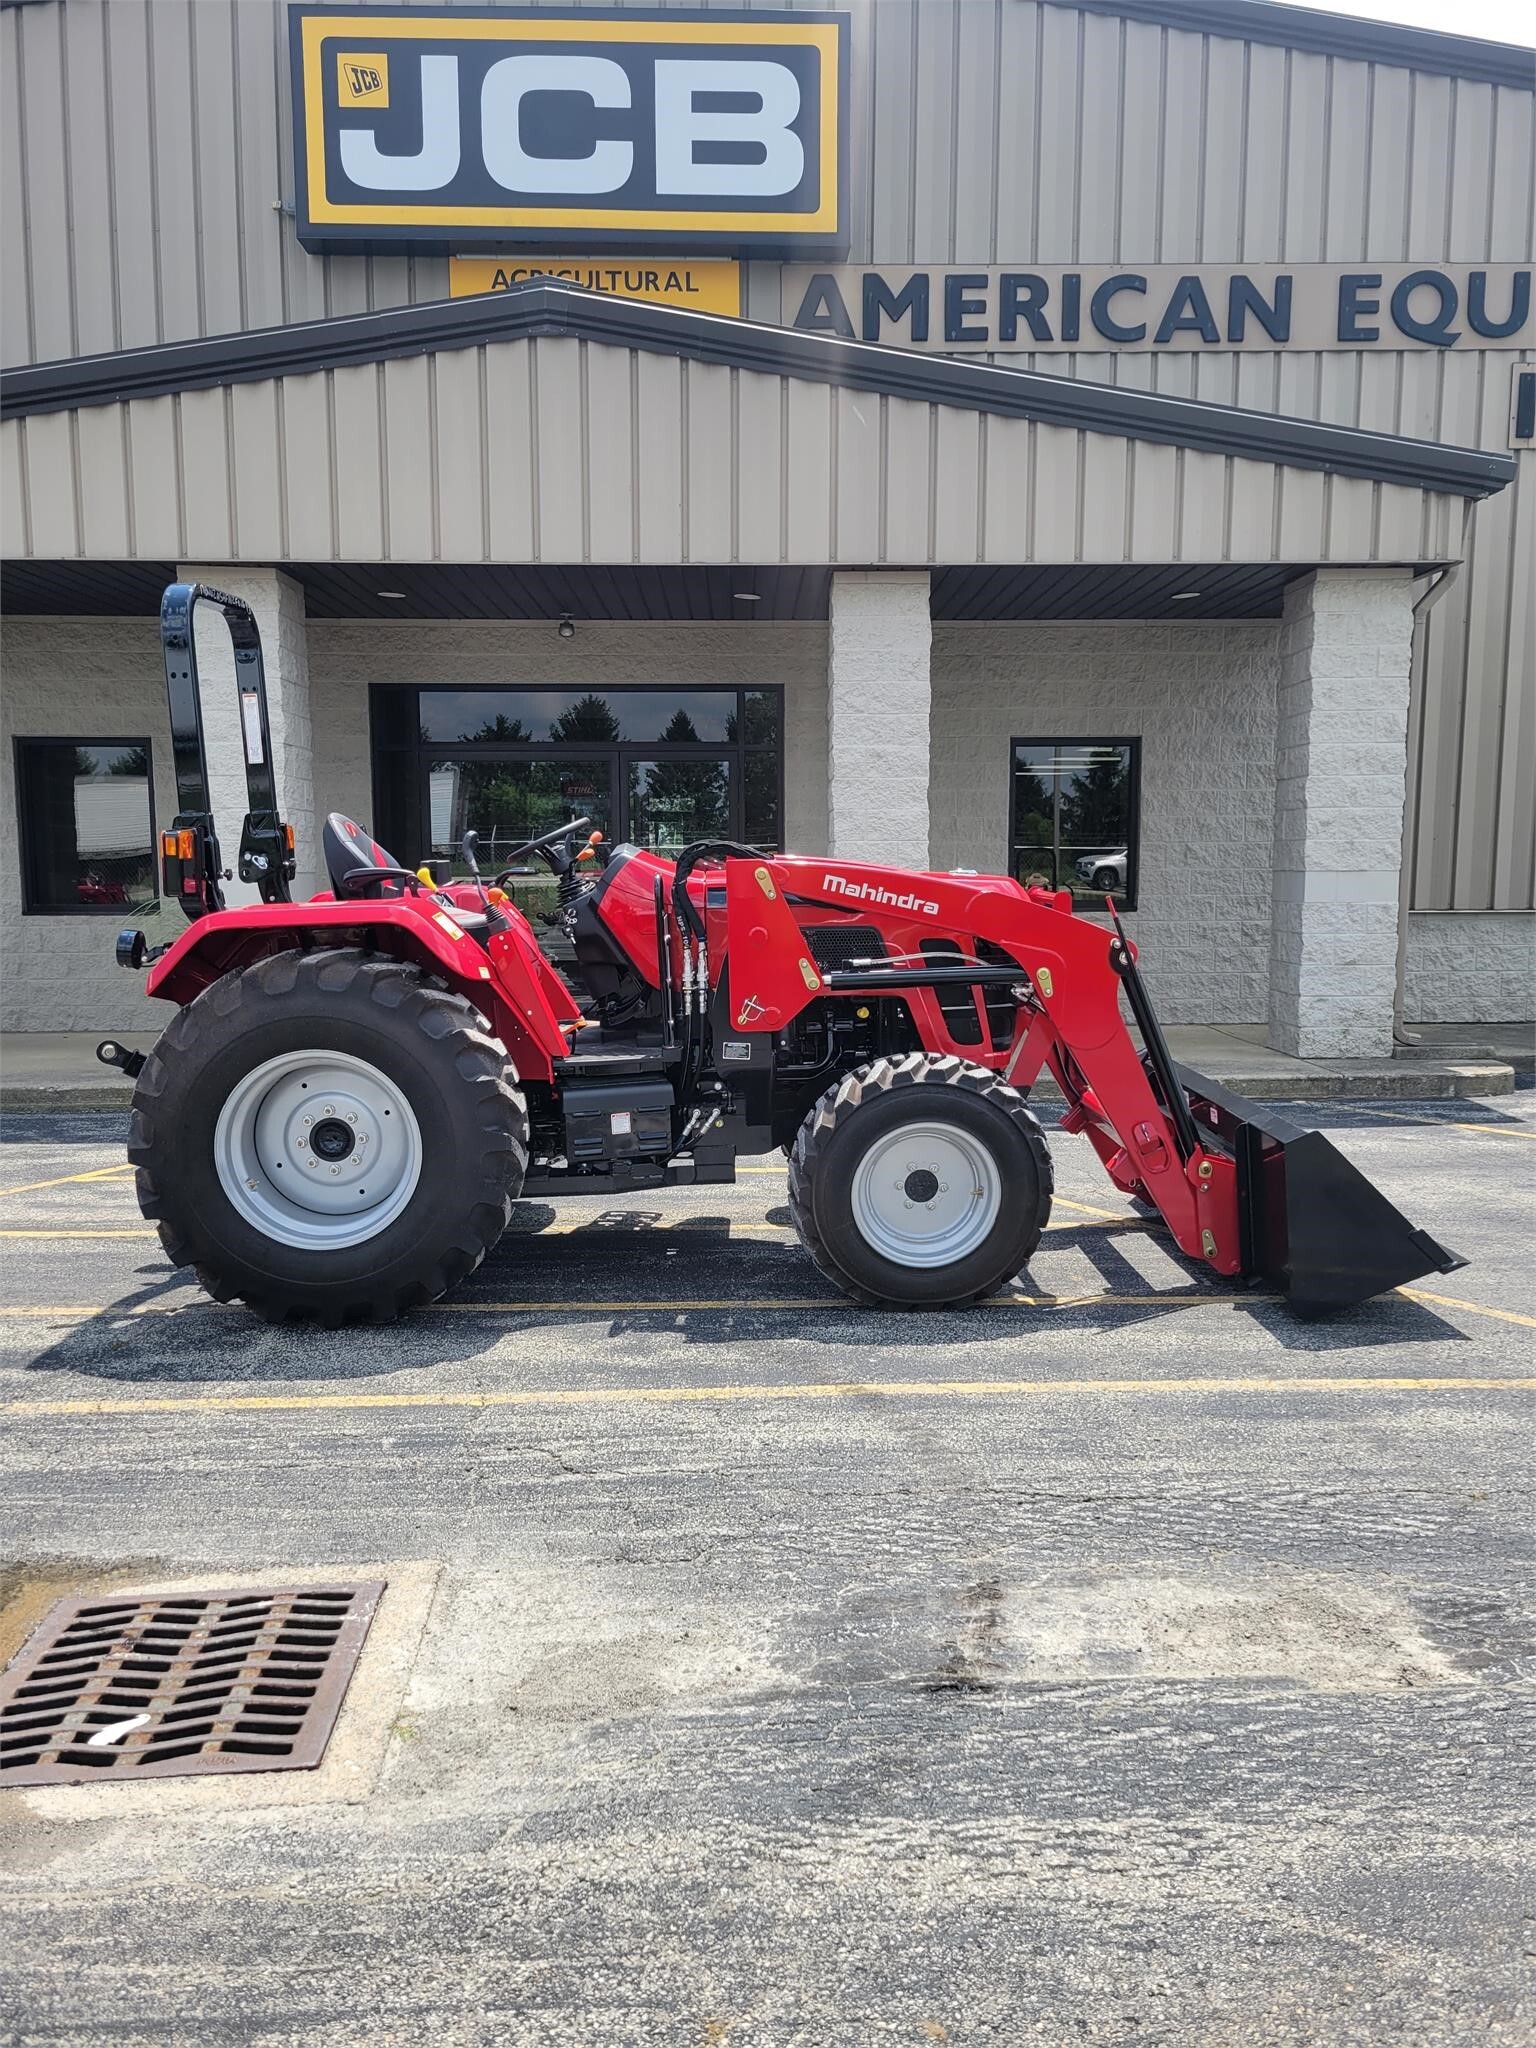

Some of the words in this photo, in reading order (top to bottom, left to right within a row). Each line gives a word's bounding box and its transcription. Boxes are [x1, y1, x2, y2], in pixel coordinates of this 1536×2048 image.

[350, 67, 381, 94] JCB
[339, 55, 804, 196] JCB
[793, 272, 1293, 343] AMERICAN
[1337, 270, 1531, 348] EQU
[567, 786, 593, 794] STIHL
[822, 874, 940, 915] Mahindra
